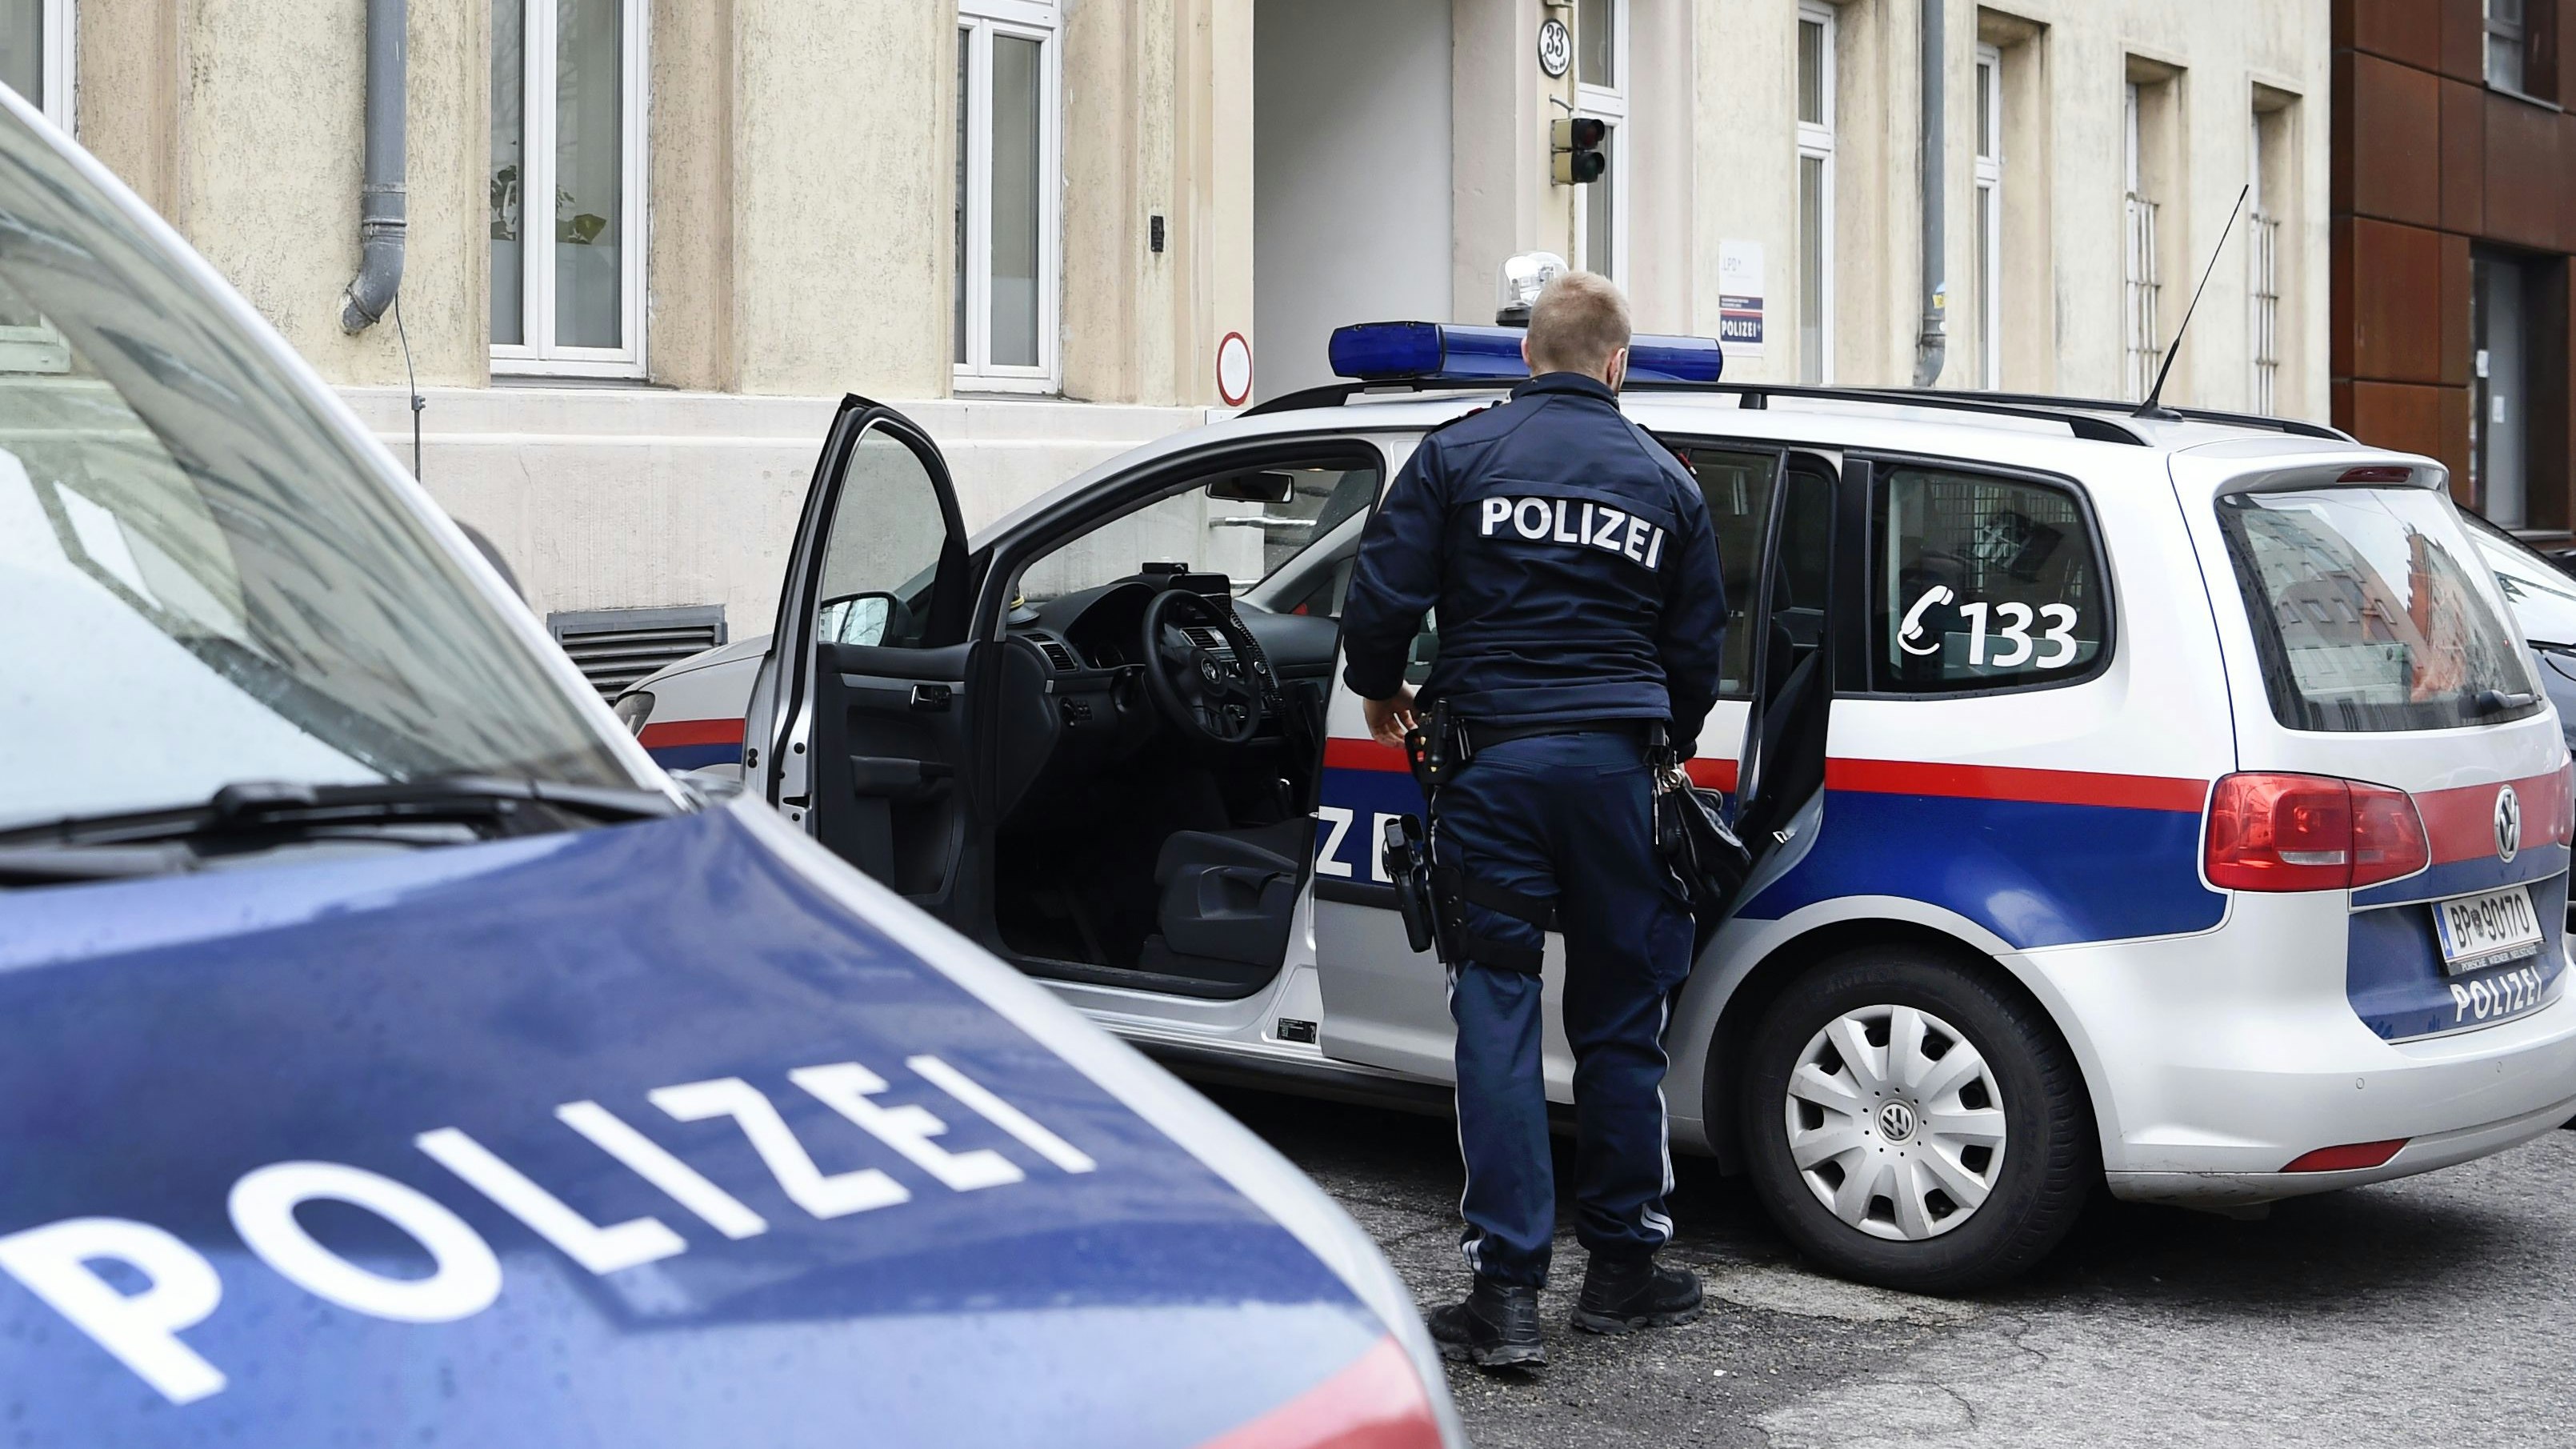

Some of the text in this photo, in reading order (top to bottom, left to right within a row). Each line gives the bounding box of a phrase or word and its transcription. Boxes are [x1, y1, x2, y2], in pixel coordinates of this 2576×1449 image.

[1546, 24, 1563, 57] 33
[1721, 320, 1757, 338] POLIZEI
[1482, 496, 1665, 569] POLIZEI
[1959, 602, 2078, 669] 133
[2450, 894, 2530, 948] BP 90170
[2449, 966, 2542, 1023] POLIZEI
[0, 1054, 1097, 1406] POLIZEI
